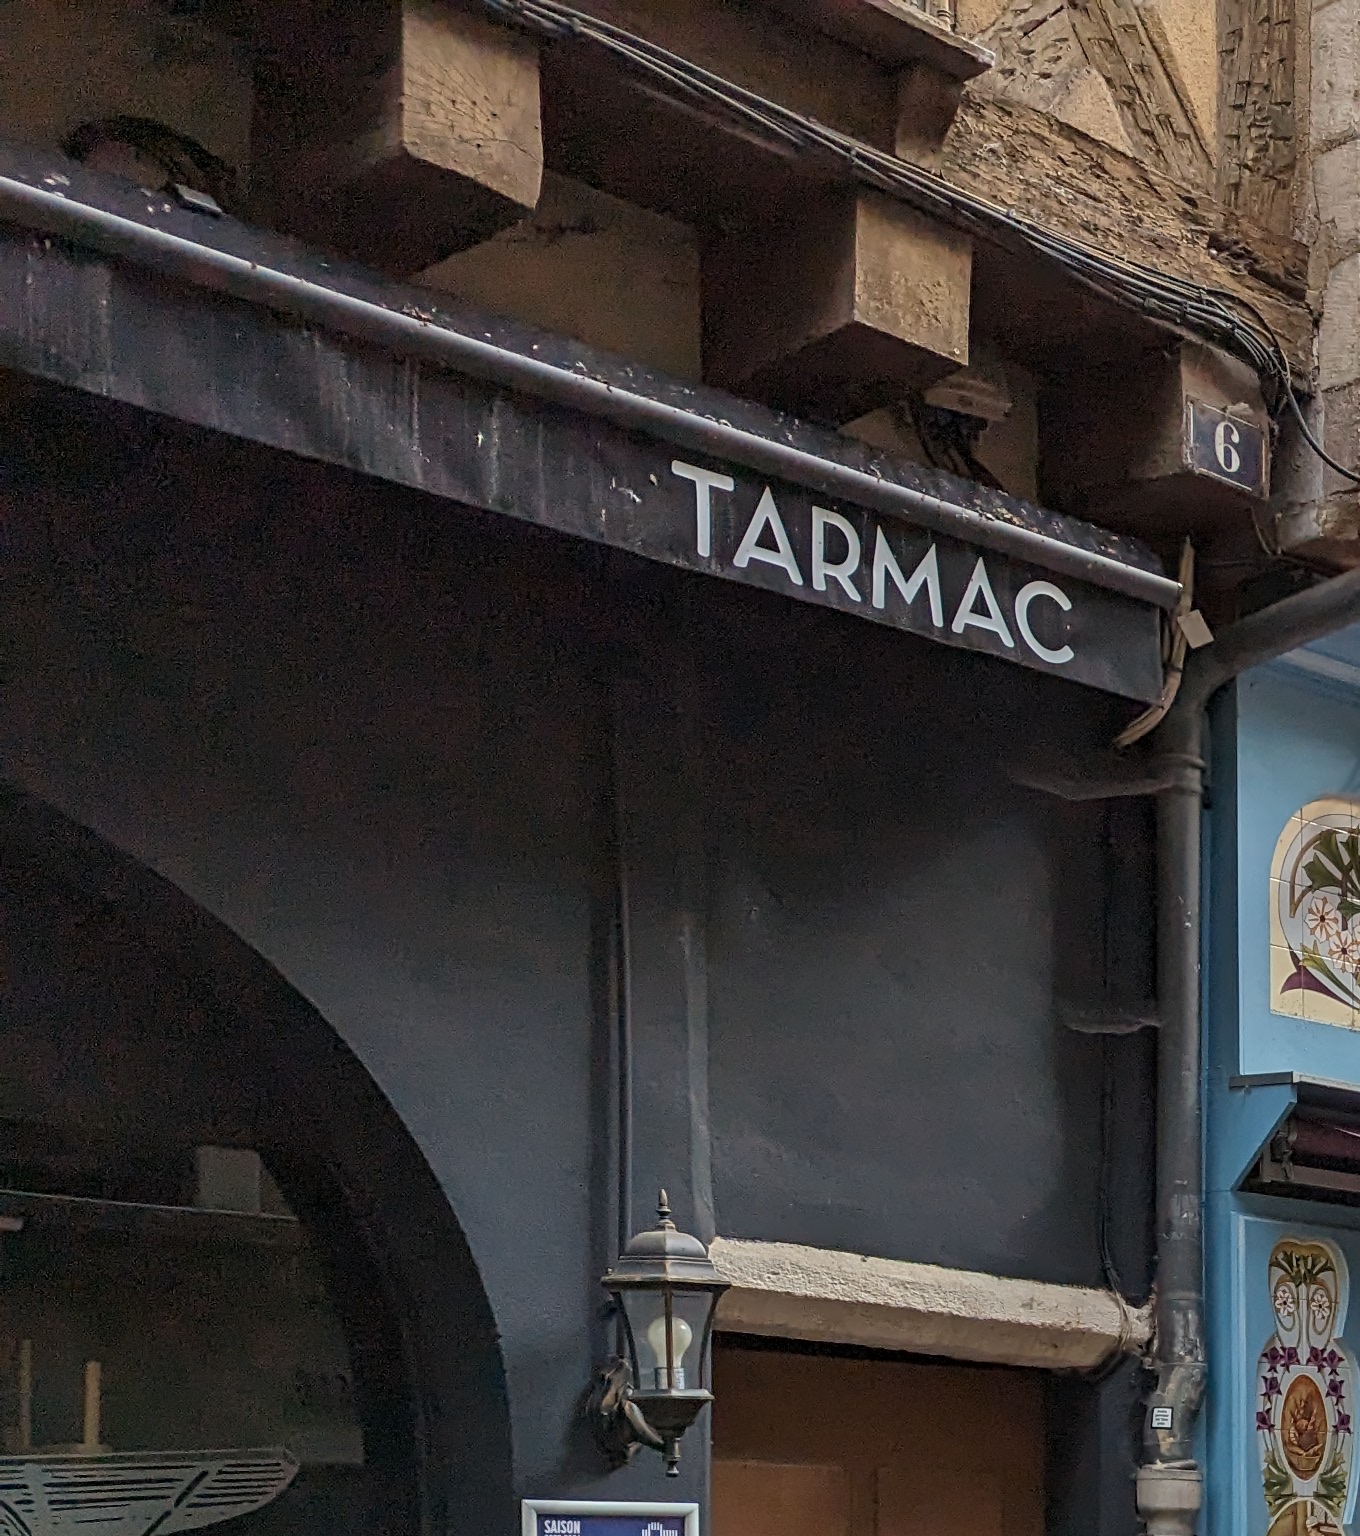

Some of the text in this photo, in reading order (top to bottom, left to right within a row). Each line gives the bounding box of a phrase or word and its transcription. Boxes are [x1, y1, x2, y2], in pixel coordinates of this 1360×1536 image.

[1215, 422, 1240, 473] 6
[671, 460, 1075, 664] TARMAC
[544, 1520, 581, 1534] SAISON
